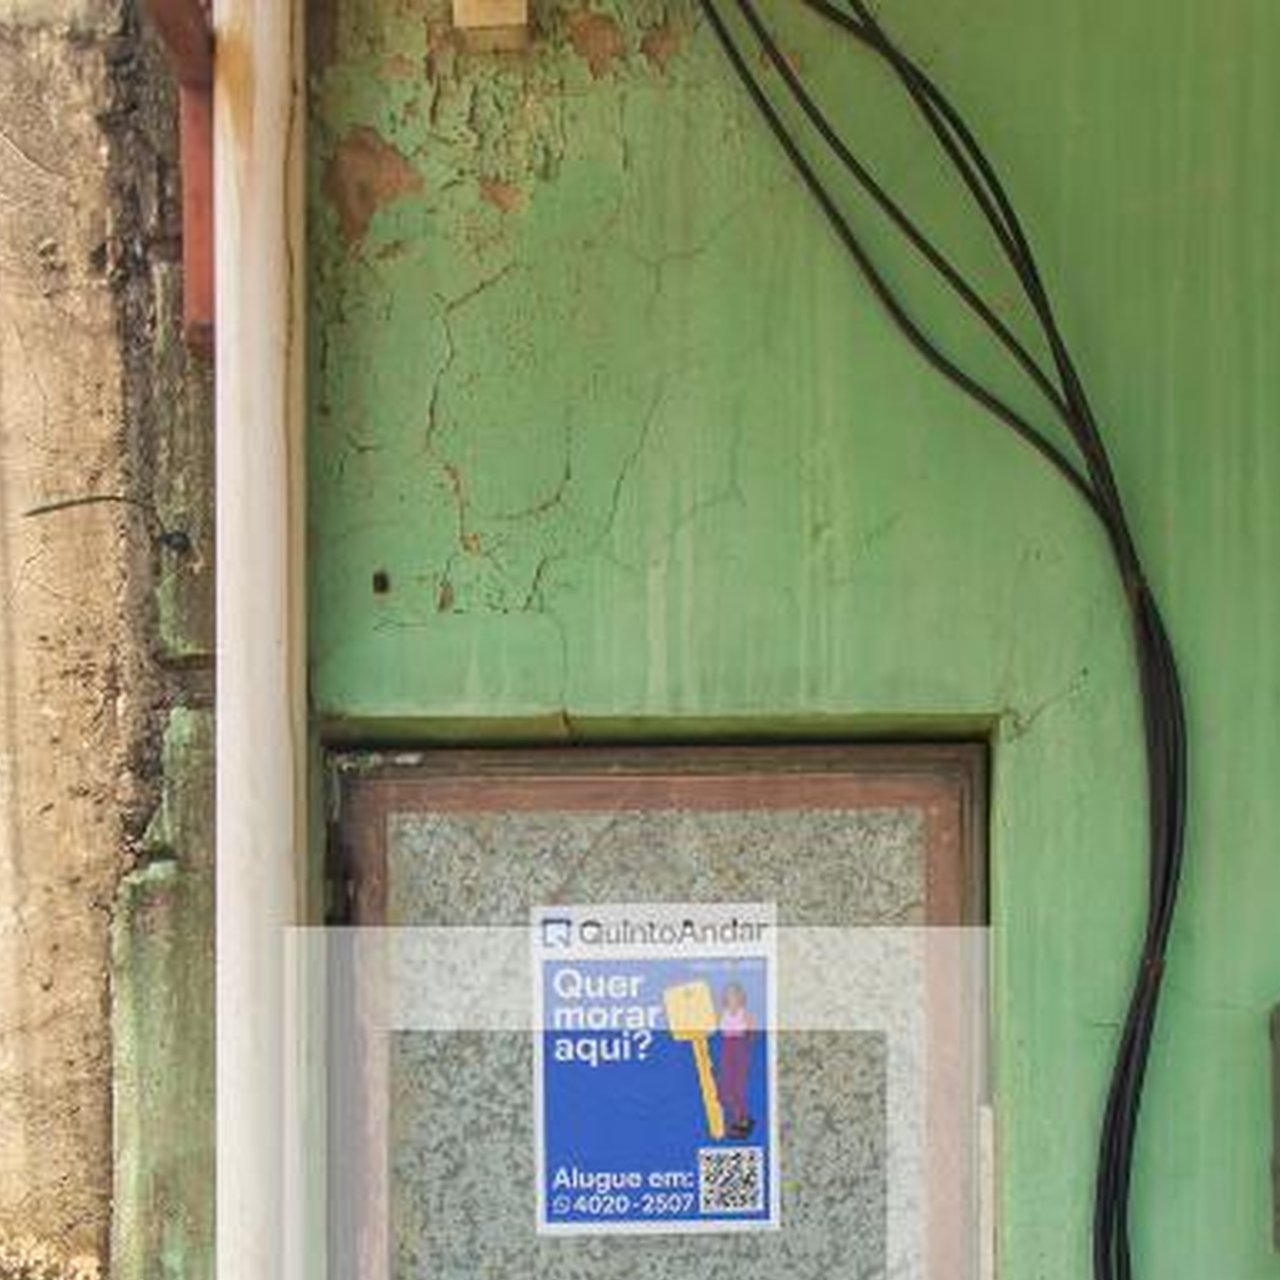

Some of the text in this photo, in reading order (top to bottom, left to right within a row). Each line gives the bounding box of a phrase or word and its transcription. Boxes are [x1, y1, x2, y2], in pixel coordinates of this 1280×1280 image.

[579, 918, 768, 945] QuintoAndar
[553, 967, 645, 999] Quer
[553, 1003, 663, 1030] morar
[554, 1029, 653, 1068] aqui?
[552, 1166, 695, 1194] Alugue em:
